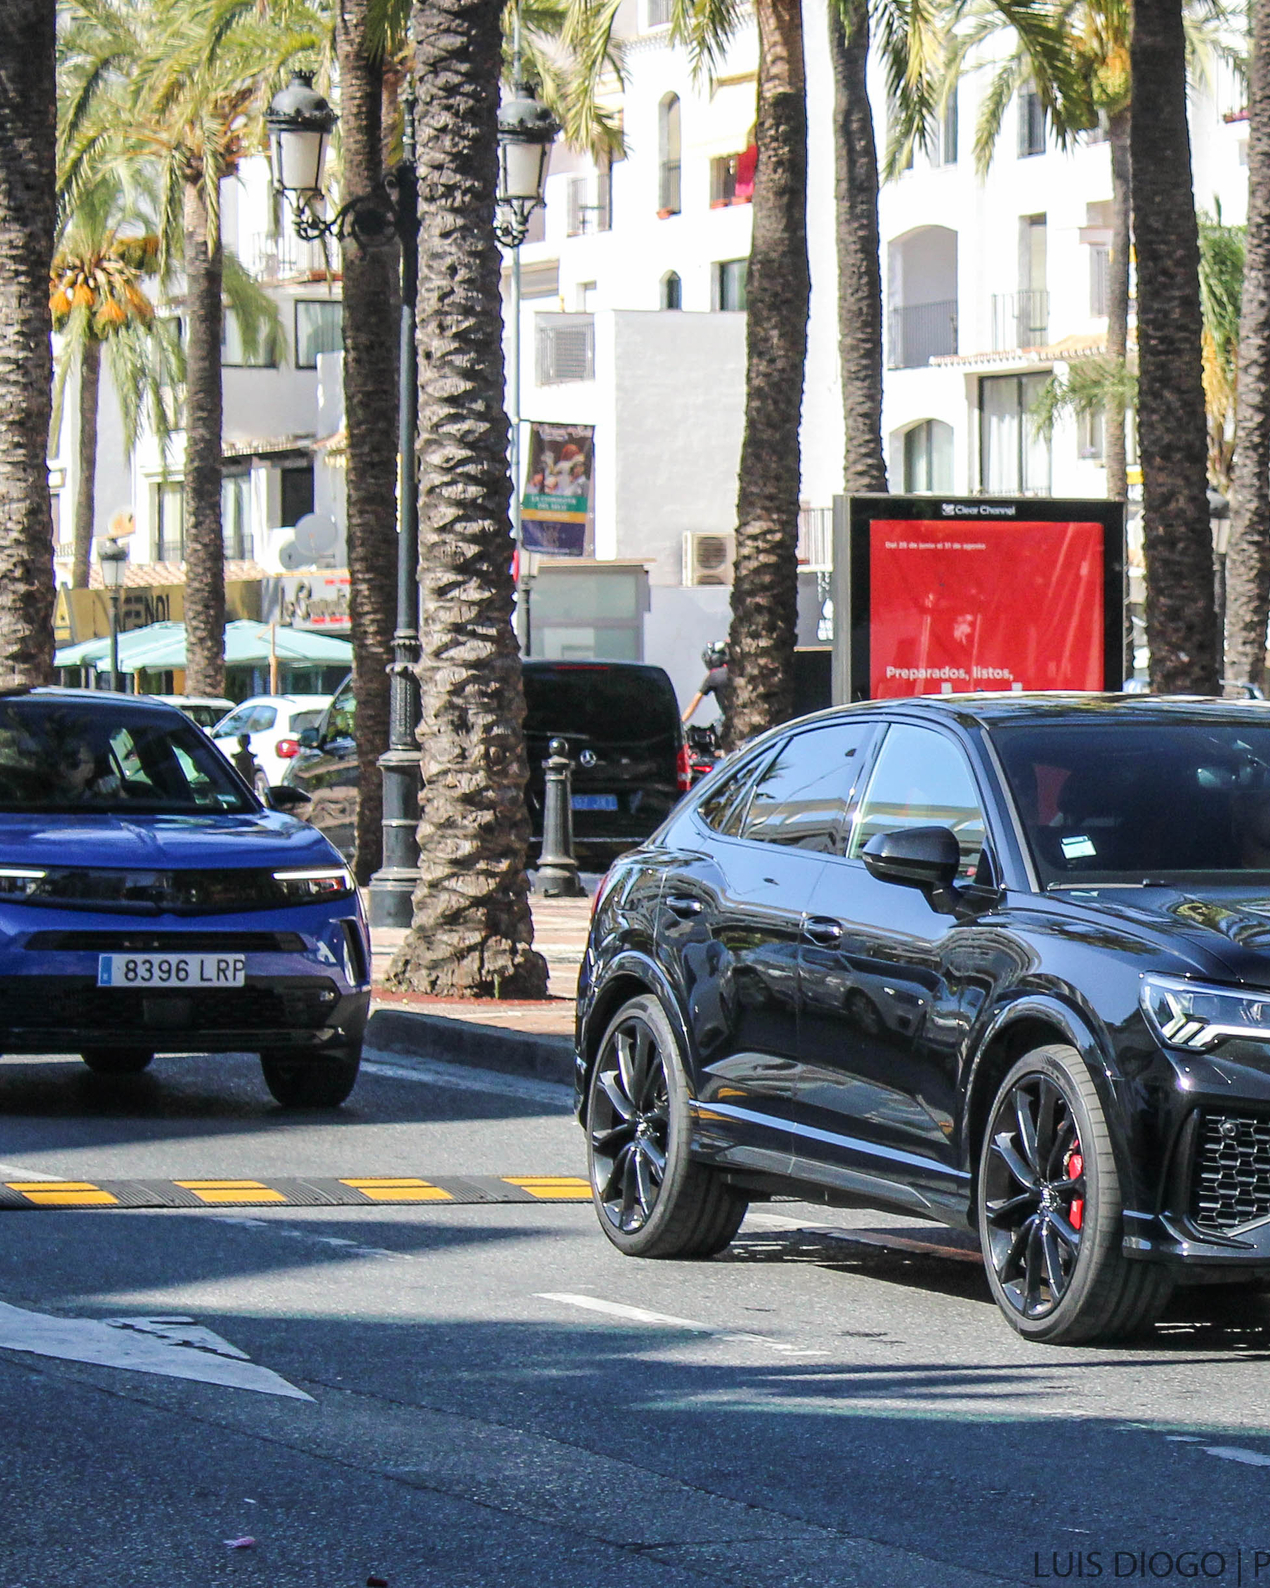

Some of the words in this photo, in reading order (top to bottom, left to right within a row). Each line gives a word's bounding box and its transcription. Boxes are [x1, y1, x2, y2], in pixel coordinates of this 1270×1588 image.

[956, 505, 979, 515] Clear
[980, 505, 1016, 516] Channel
[886, 666, 969, 681] Preparados,
[972, 666, 1013, 681] listos,
[124, 959, 189, 982] 8396
[200, 959, 245, 982] LRP
